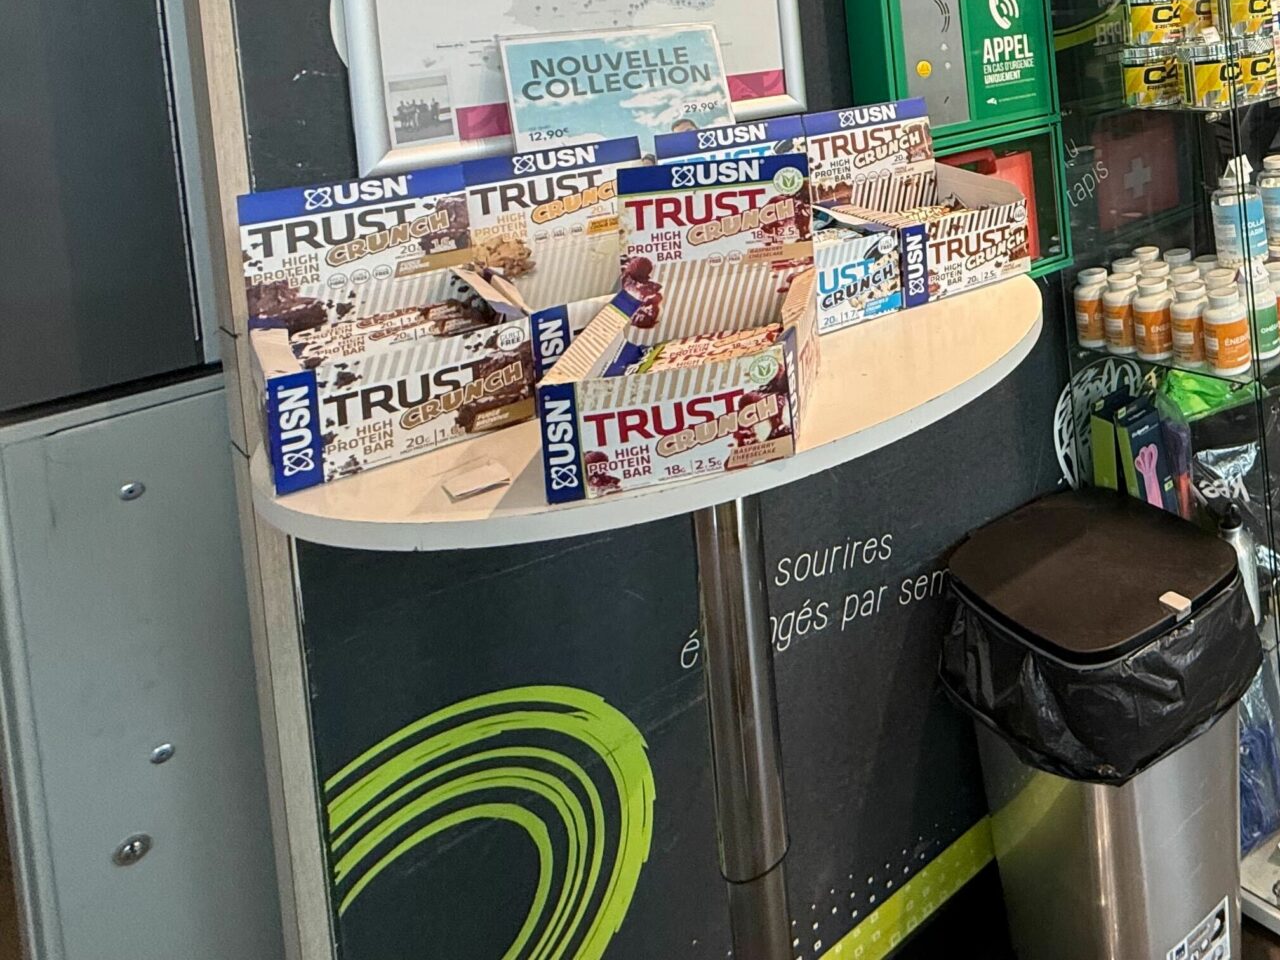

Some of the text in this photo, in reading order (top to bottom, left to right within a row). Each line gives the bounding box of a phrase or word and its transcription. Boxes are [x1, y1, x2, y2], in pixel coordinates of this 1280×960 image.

[983, 33, 1034, 64] APPEL
[530, 46, 690, 79] NOUVELLE
[983, 57, 1036, 75] EN CAS D'URGENCE
[521, 63, 712, 101] COLLECTION
[984, 70, 1022, 86] UNIQUEMENT
[1143, 65, 1179, 86] C4
[857, 104, 897, 125] USN
[717, 123, 767, 146] USN
[811, 123, 902, 161] TRUST
[536, 144, 597, 170] USN
[853, 129, 921, 170] CRUNCH
[697, 160, 761, 187] USN
[814, 166, 851, 179] PROTEIN
[830, 158, 851, 168] HIGH
[834, 172, 852, 182] BAR
[333, 175, 408, 205] USN
[470, 170, 603, 216] TRUST
[496, 212, 526, 224] HIGH
[625, 189, 766, 231] TRUST
[247, 202, 416, 259] TRUST
[474, 220, 528, 238] PROTEIN
[687, 198, 796, 246] CRUNCH
[325, 209, 450, 267] CRUNCH
[502, 229, 528, 241] BAR
[651, 230, 681, 243] HIGH
[929, 225, 1011, 265] TRUST
[627, 239, 682, 255] PROTEIN
[656, 250, 682, 263] BAR
[907, 233, 924, 281] USN
[965, 228, 1028, 272] CRUNCH
[282, 253, 319, 268] HIGH
[944, 261, 963, 274] HIGH
[252, 264, 320, 285] PROTEIN
[289, 275, 321, 289] BAR
[819, 258, 876, 294] UST
[930, 269, 963, 283] PROTEIN
[946, 277, 963, 287] BAR
[820, 264, 894, 310] CRUNCH
[500, 337, 522, 347] FREE
[322, 355, 486, 428] TRUST
[399, 360, 525, 430] CRUNCH
[277, 384, 314, 448] USN
[583, 389, 746, 447] TRUST
[655, 393, 779, 458] CRUNCH
[356, 418, 393, 438] HIGH
[545, 398, 577, 464] USN
[325, 429, 394, 456] PROTEIN
[363, 439, 395, 456] BAR
[614, 444, 651, 460] HIGH
[732, 442, 776, 455] RASPBERRY
[587, 455, 652, 476] PROTEIN
[732, 448, 777, 462] CHEESECAKE
[622, 466, 653, 481] BAR
[775, 533, 893, 586] sourires
[841, 585, 889, 632] par
